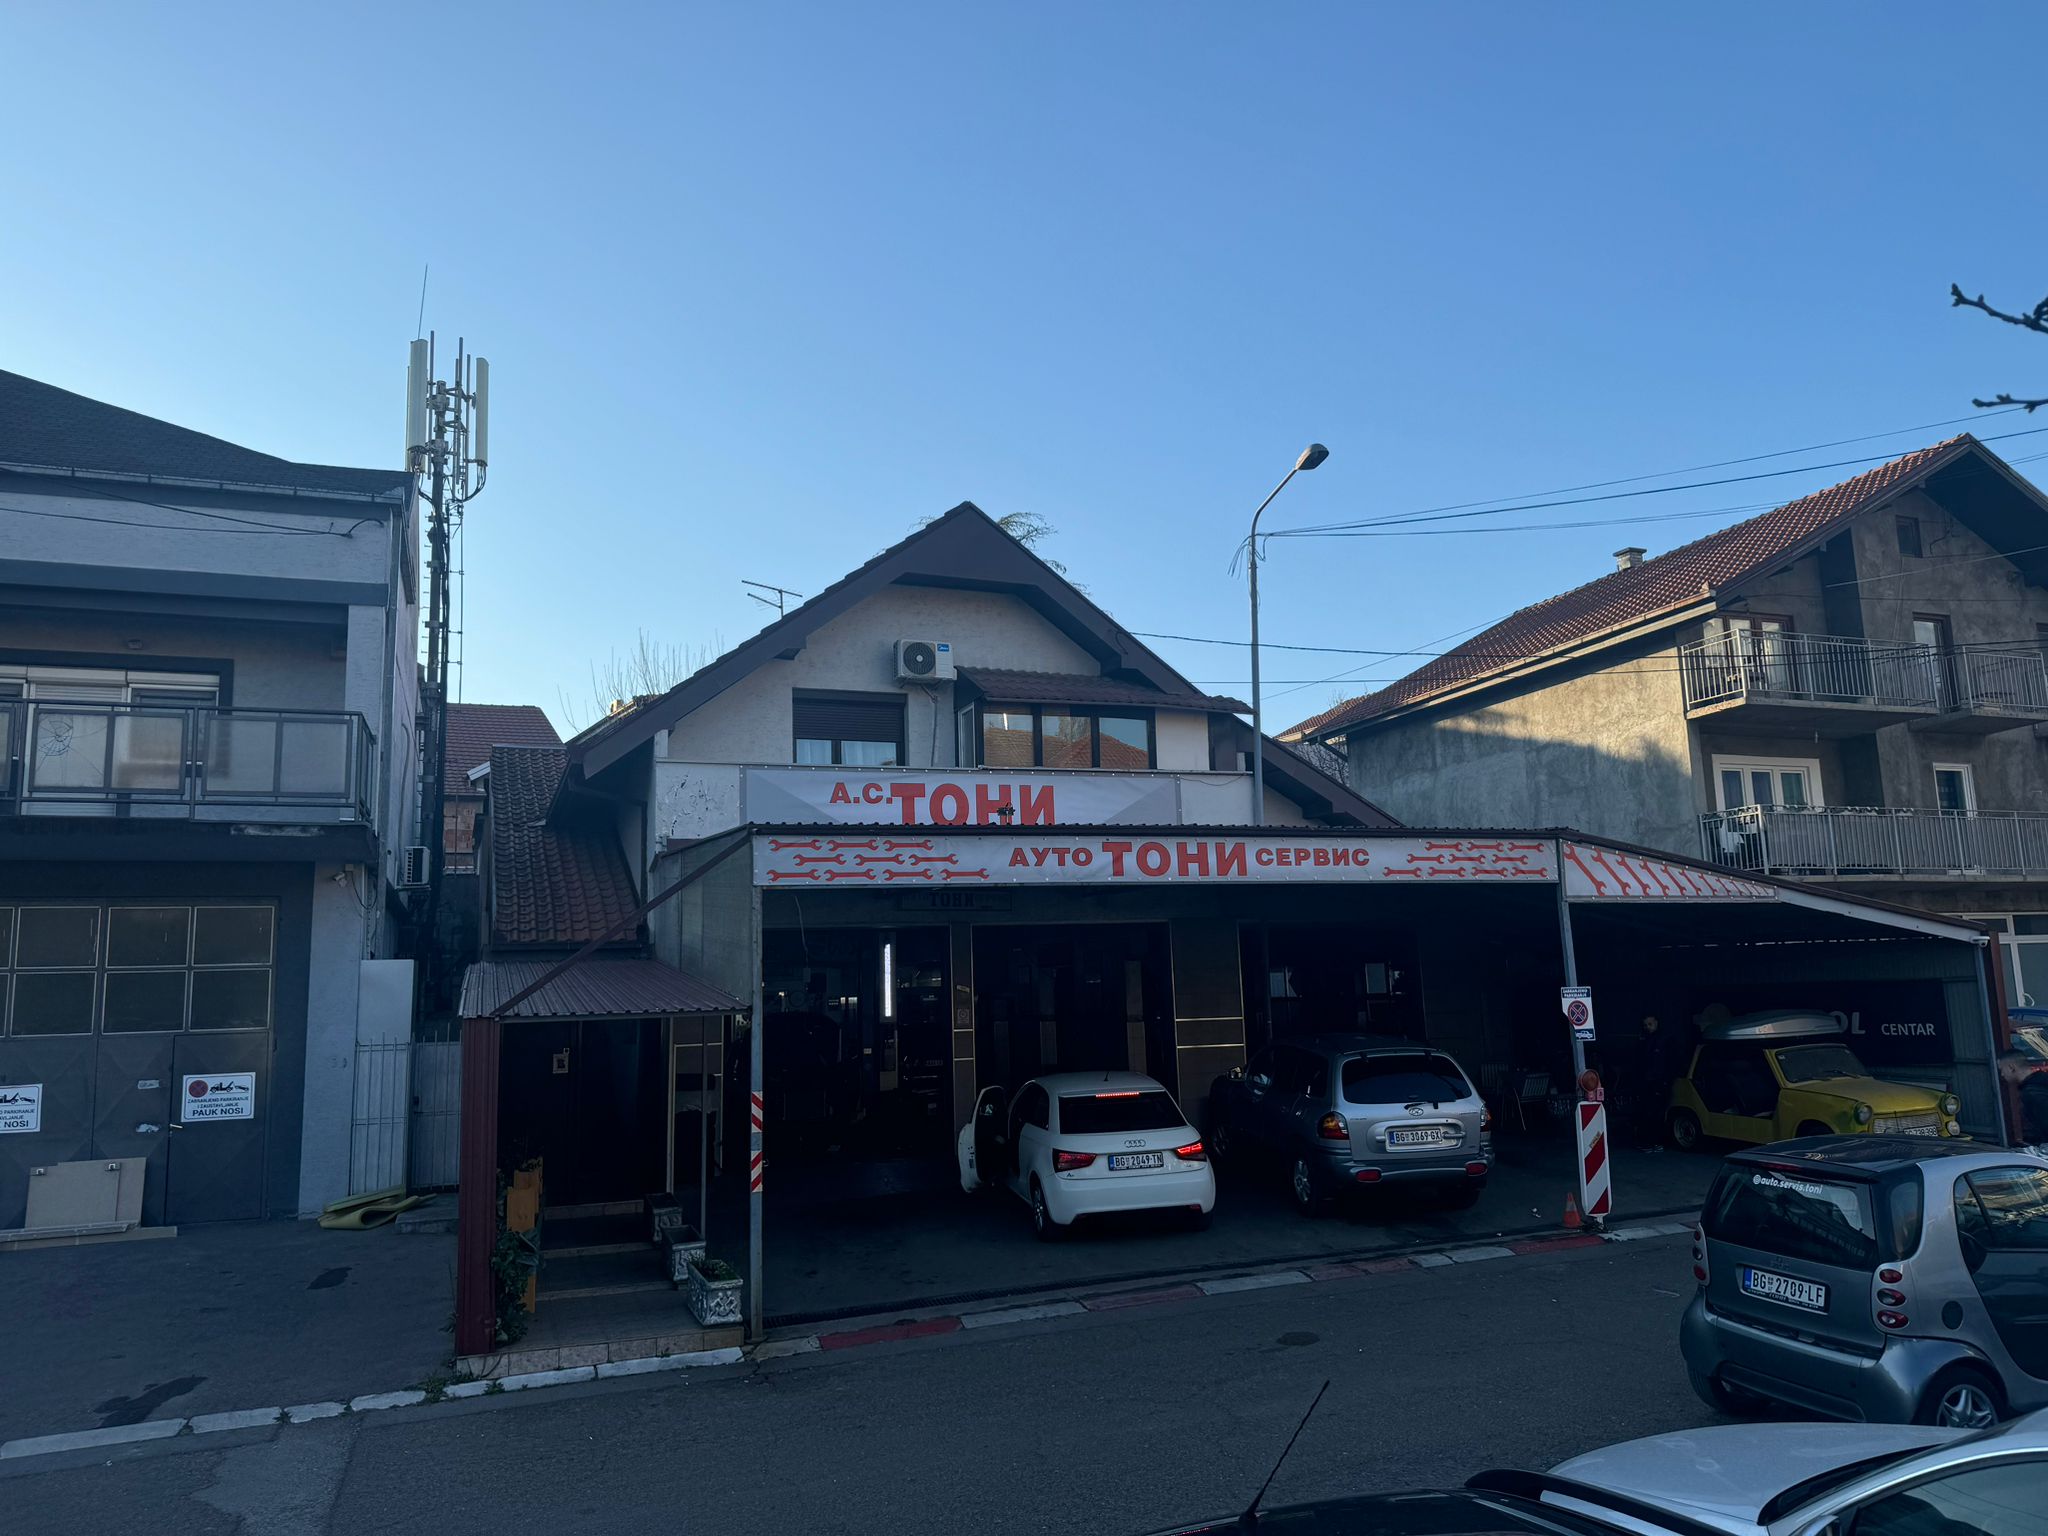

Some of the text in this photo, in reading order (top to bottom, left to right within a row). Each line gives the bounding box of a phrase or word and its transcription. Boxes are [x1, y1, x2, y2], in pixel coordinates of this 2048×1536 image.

[890, 783, 1055, 825] ТОНИ
[1008, 842, 1370, 877] АУТО ТОНИ СЕРВИС
[1881, 1023, 1936, 1036] CENTAR
[192, 1107, 244, 1117] PAUK NOSI
[4, 1120, 29, 1128] NOSI
[1395, 1133, 1406, 1142] BG
[1115, 1156, 1126, 1167] BG
[1753, 1271, 1767, 1289] BG
